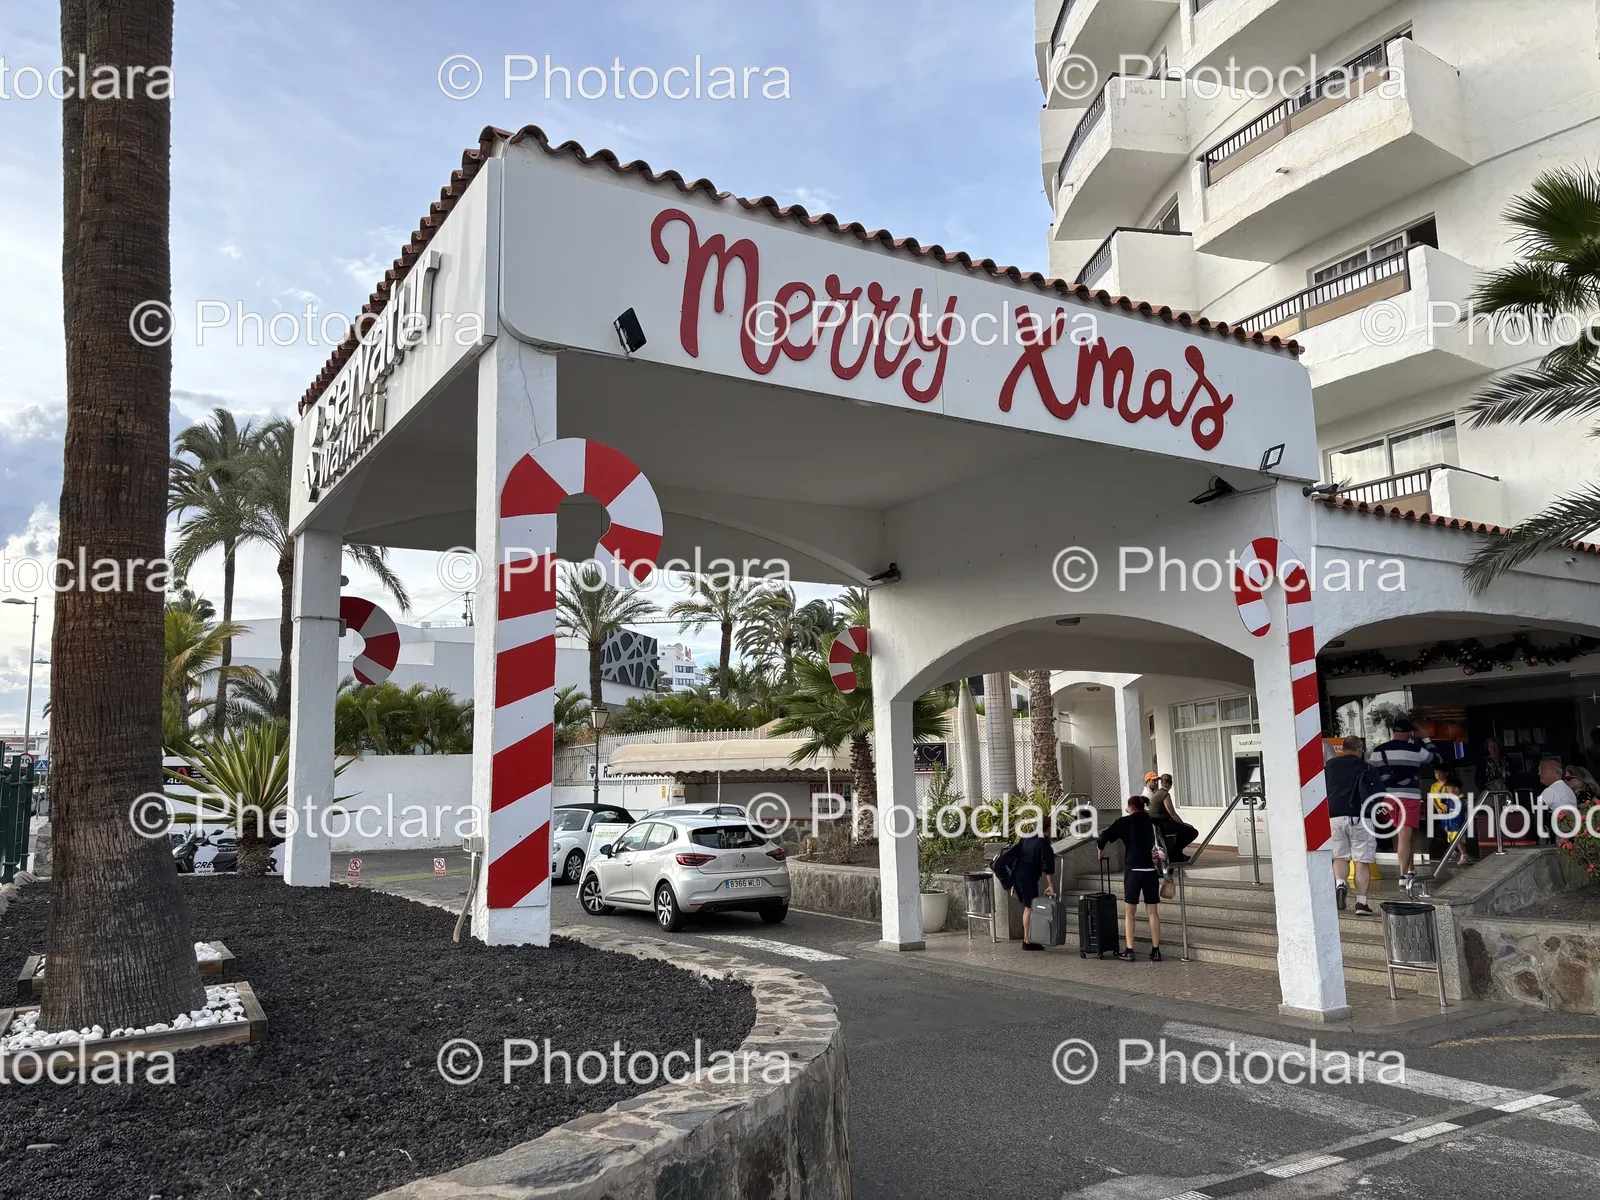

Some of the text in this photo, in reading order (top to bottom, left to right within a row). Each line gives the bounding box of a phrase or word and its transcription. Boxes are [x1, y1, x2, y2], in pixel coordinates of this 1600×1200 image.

[322, 250, 440, 441] servatur
[650, 208, 1233, 450] Merry Xmas
